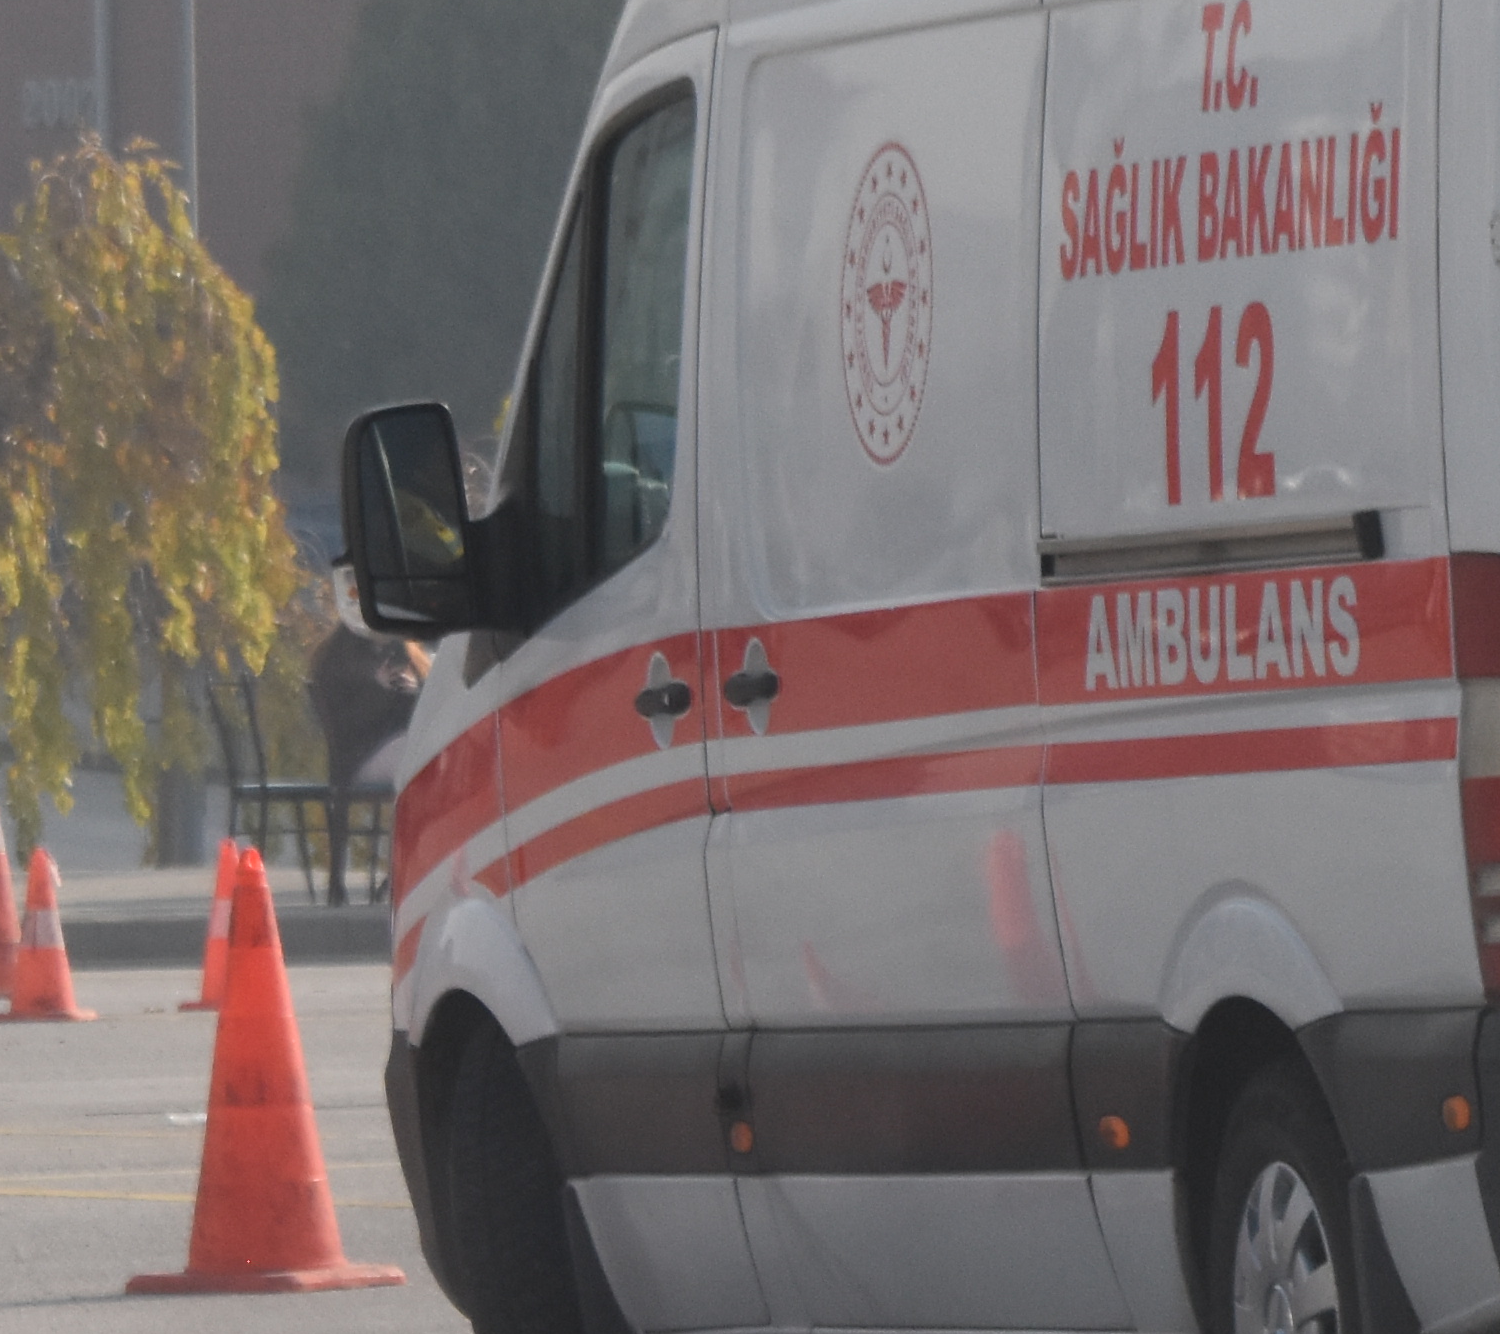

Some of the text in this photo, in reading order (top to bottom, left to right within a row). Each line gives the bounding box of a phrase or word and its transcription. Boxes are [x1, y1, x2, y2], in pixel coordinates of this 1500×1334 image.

[1060, 101, 1402, 281] SAĞLIK BAKANLIĞI
[1151, 300, 1276, 506] 112
[1084, 574, 1361, 691] AMBULANS
